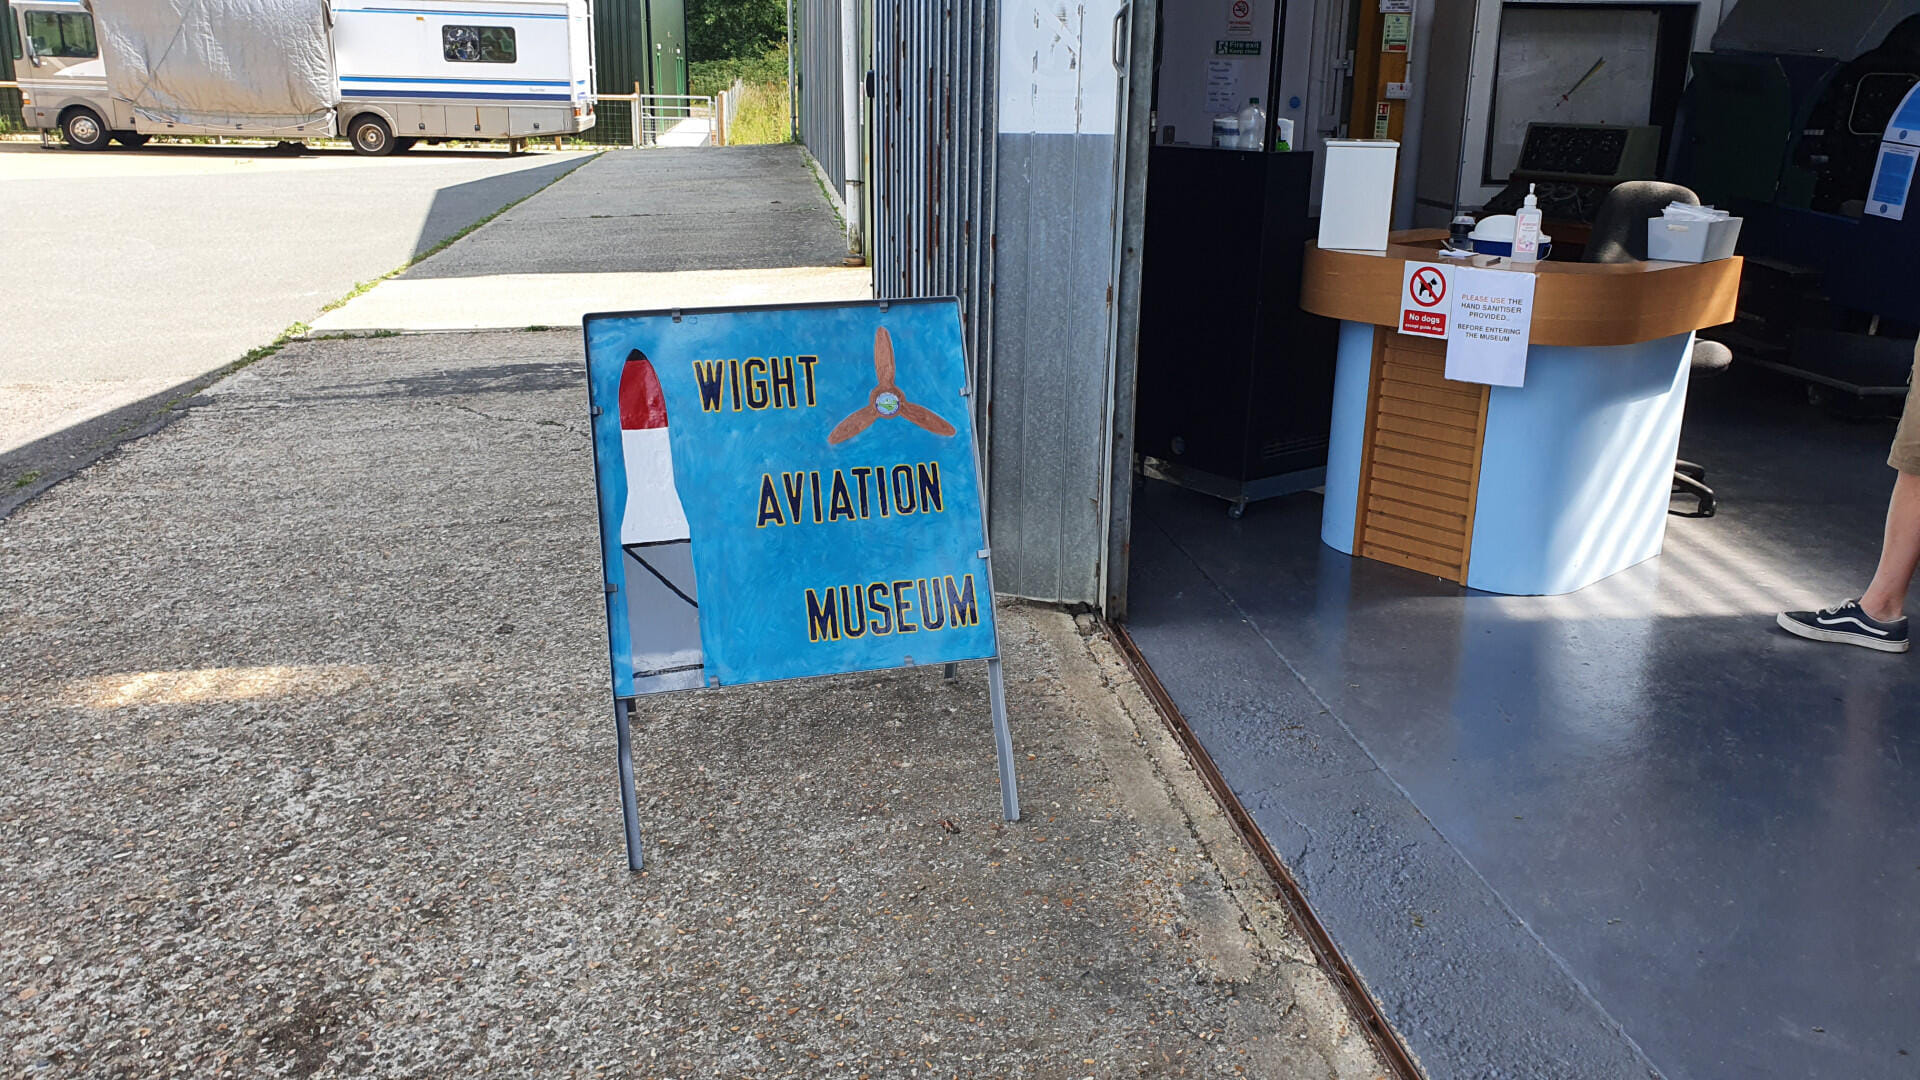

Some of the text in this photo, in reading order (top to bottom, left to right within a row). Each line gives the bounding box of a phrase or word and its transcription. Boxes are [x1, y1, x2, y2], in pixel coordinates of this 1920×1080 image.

[1461, 293, 1523, 306] PLEASE USE THE
[1461, 302, 1522, 314] HAND SANITISER
[1409, 313, 1440, 325] No dogs
[1457, 323, 1521, 336] BEFORE ENTERING
[1479, 334, 1510, 342] MUSEUM
[693, 355, 819, 412] WIGHT
[756, 462, 944, 528] AVIATION
[804, 574, 979, 642] MUSEUM
